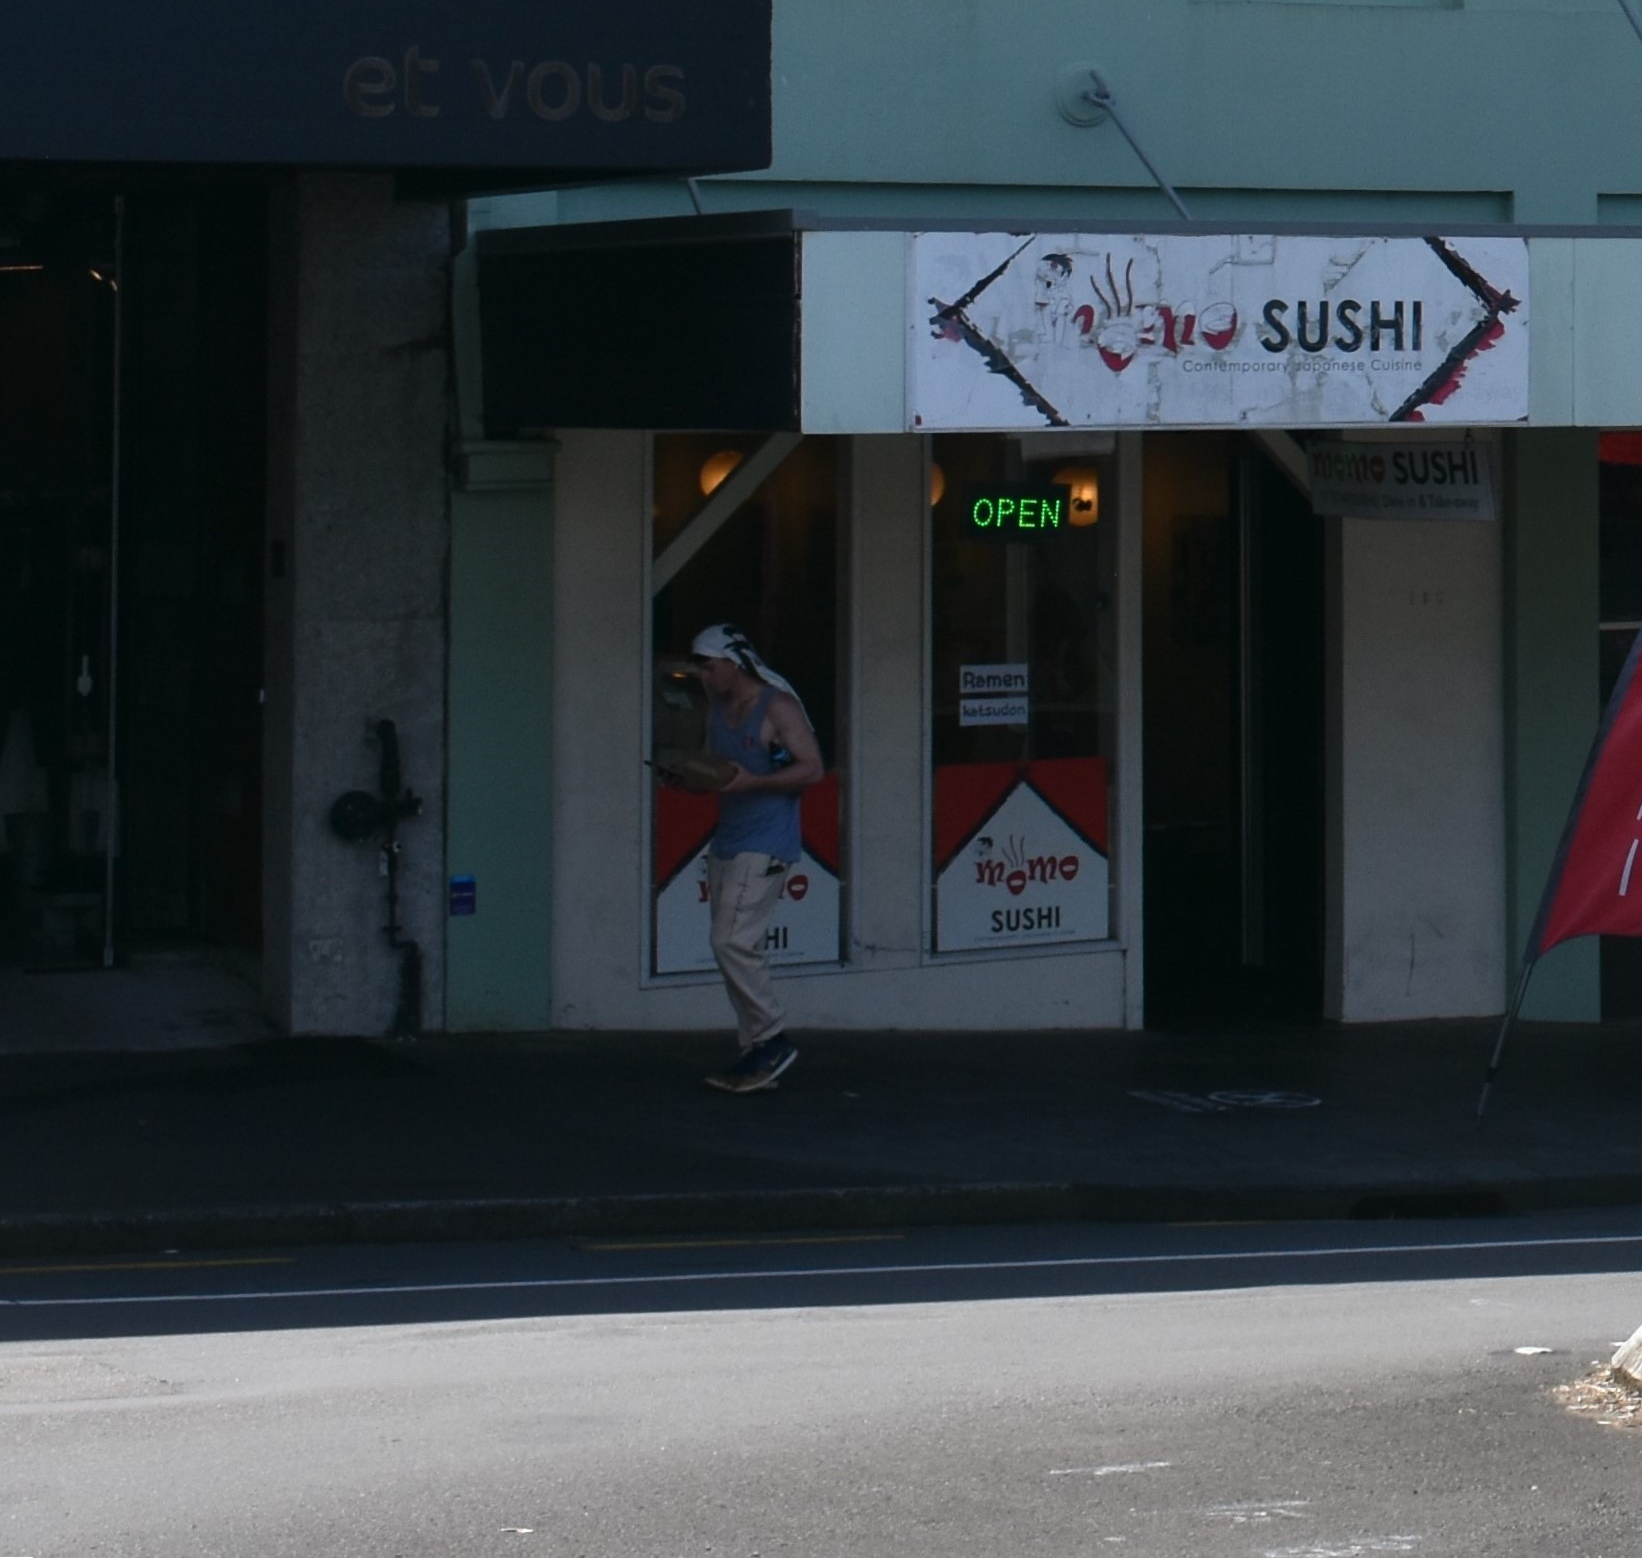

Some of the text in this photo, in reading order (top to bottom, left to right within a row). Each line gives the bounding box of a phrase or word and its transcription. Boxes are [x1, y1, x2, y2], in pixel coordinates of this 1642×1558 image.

[343, 45, 686, 123] et vous
[1260, 298, 1422, 353] SUSHI
[1182, 360, 1288, 373] Contemporary
[1371, 359, 1422, 372] Cuisine
[1392, 450, 1479, 485] SUSHI
[973, 498, 1060, 528] OPEN
[962, 671, 1026, 689] Ramen
[975, 855, 1078, 895] momo
[991, 907, 1061, 933] SUSHI
